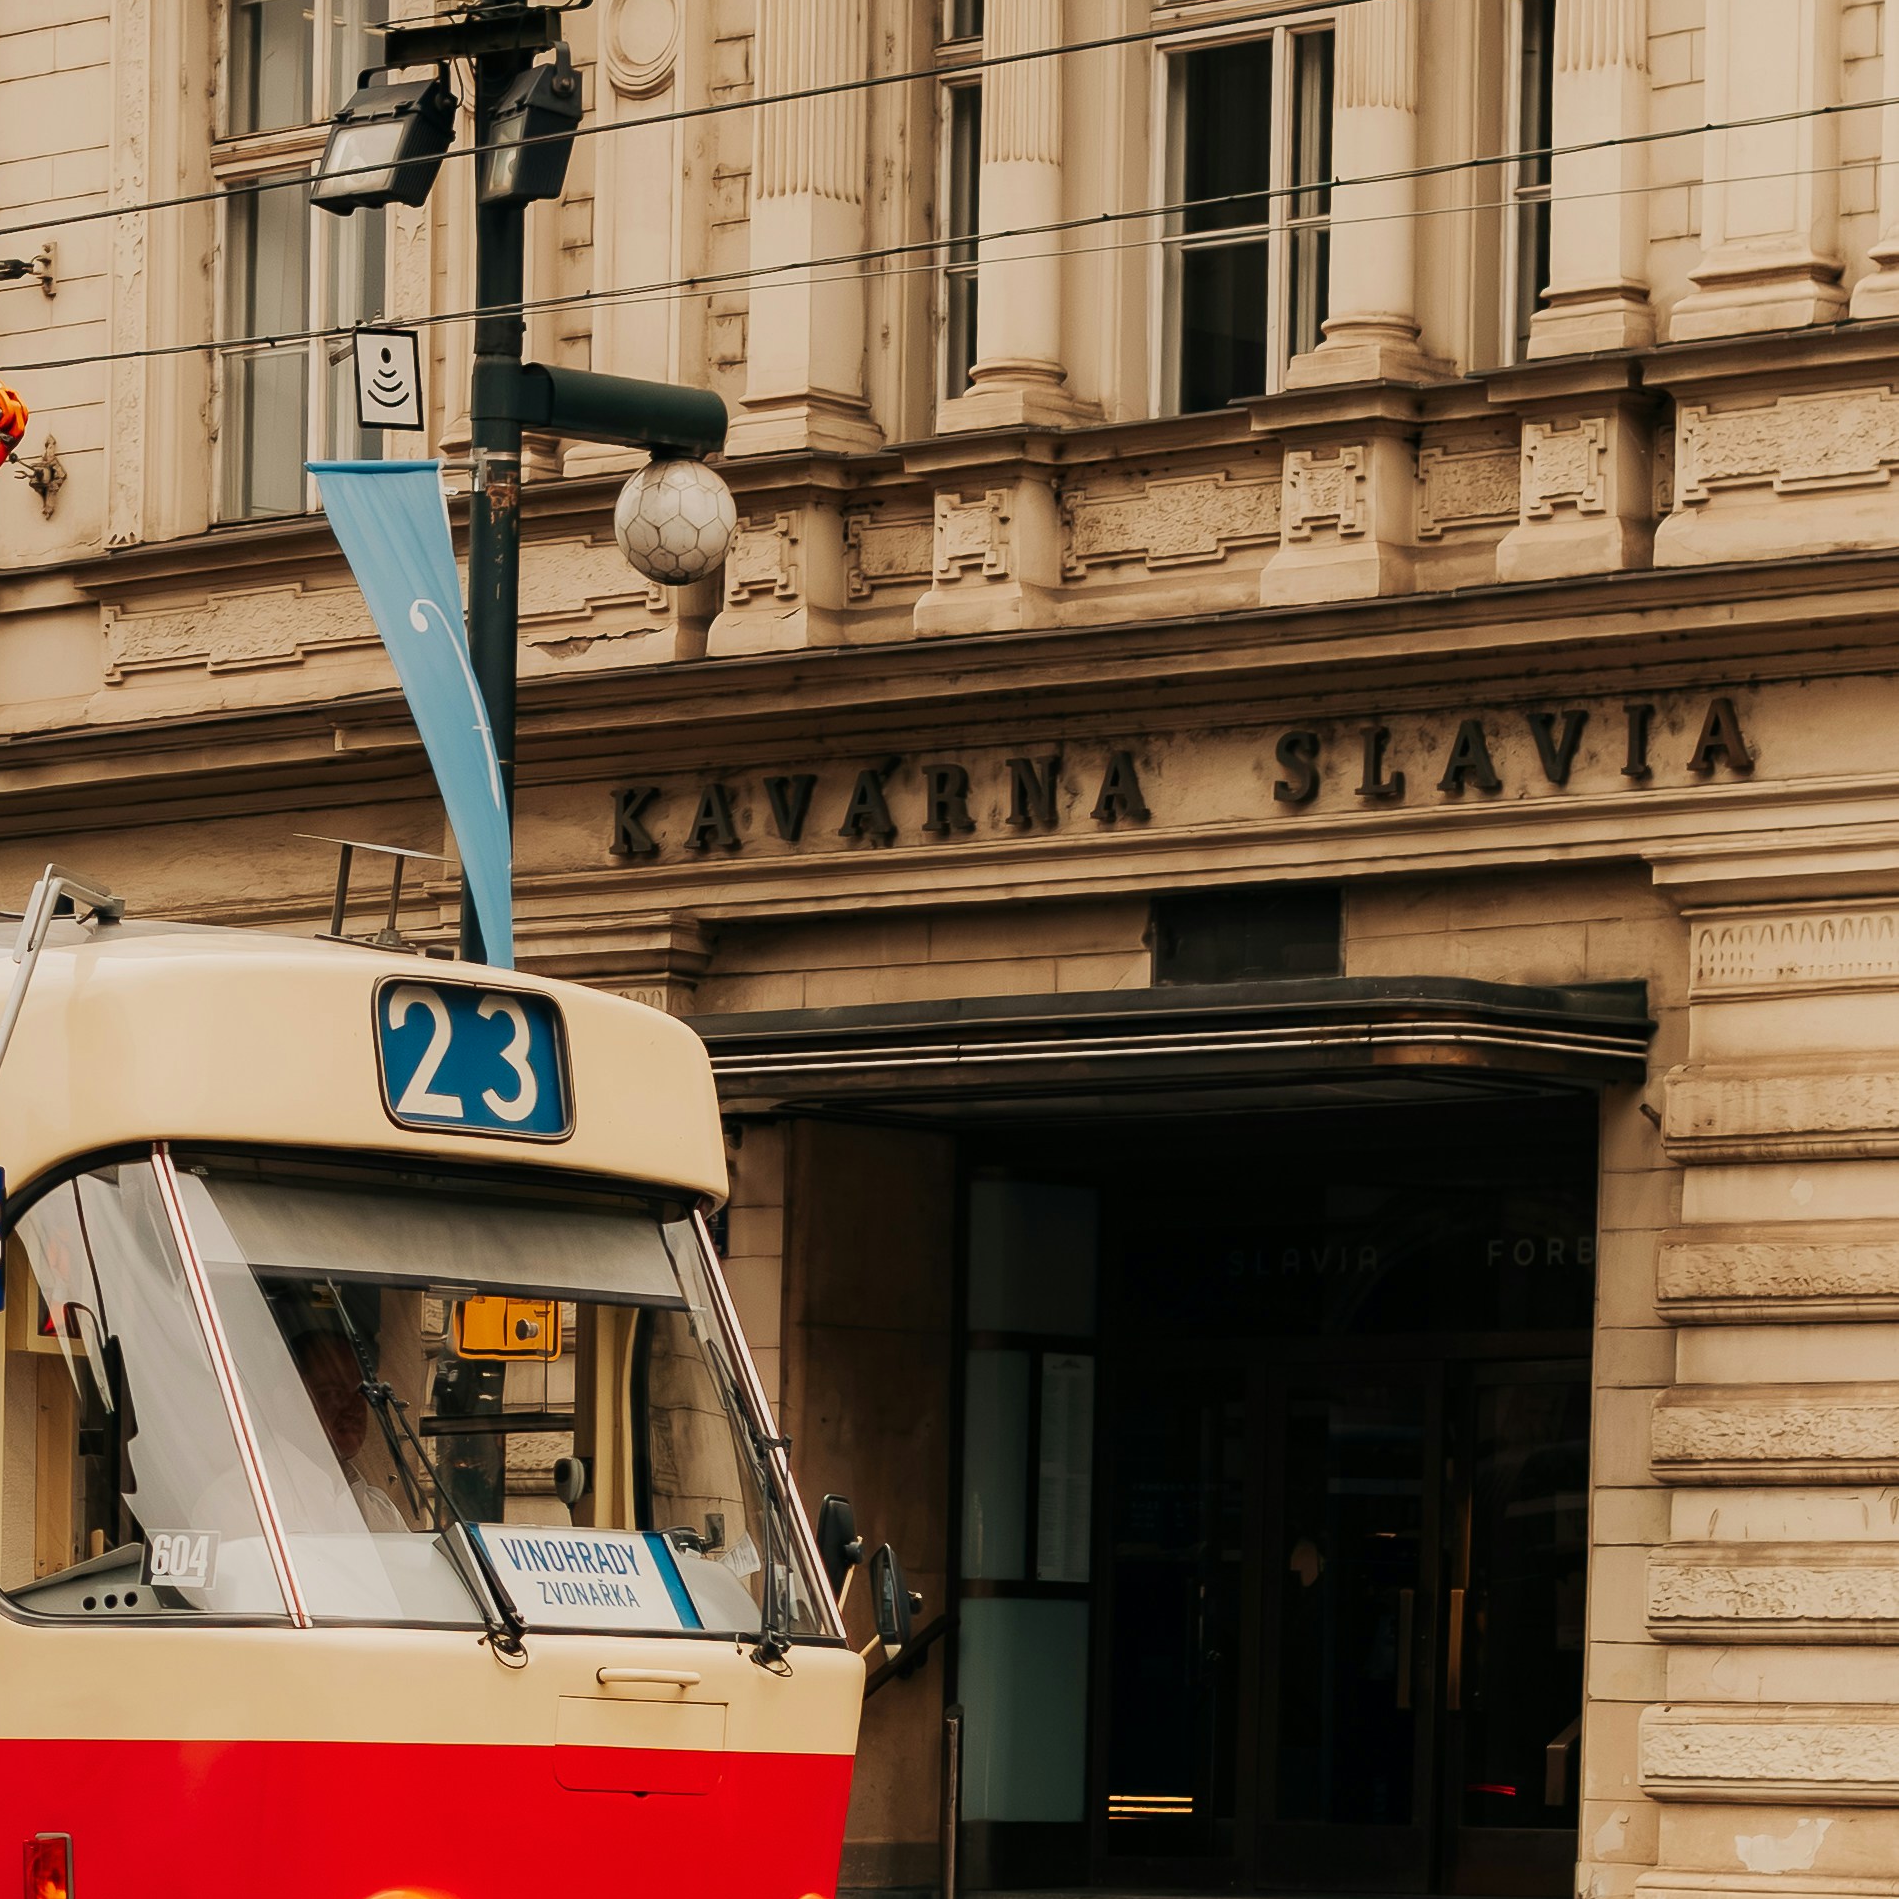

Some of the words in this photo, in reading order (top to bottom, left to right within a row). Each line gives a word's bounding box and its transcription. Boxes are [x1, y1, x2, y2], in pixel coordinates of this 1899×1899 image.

[607, 751, 1151, 856] KAVÁRNA
[1272, 697, 1755, 805] SLAVIA
[388, 985, 540, 1123] 23
[1228, 1244, 1380, 1278] SLAVIA
[150, 1533, 210, 1578] 604
[499, 1537, 641, 1577] VINOHRADY
[536, 1578, 641, 1608] ZVONAŘKA
